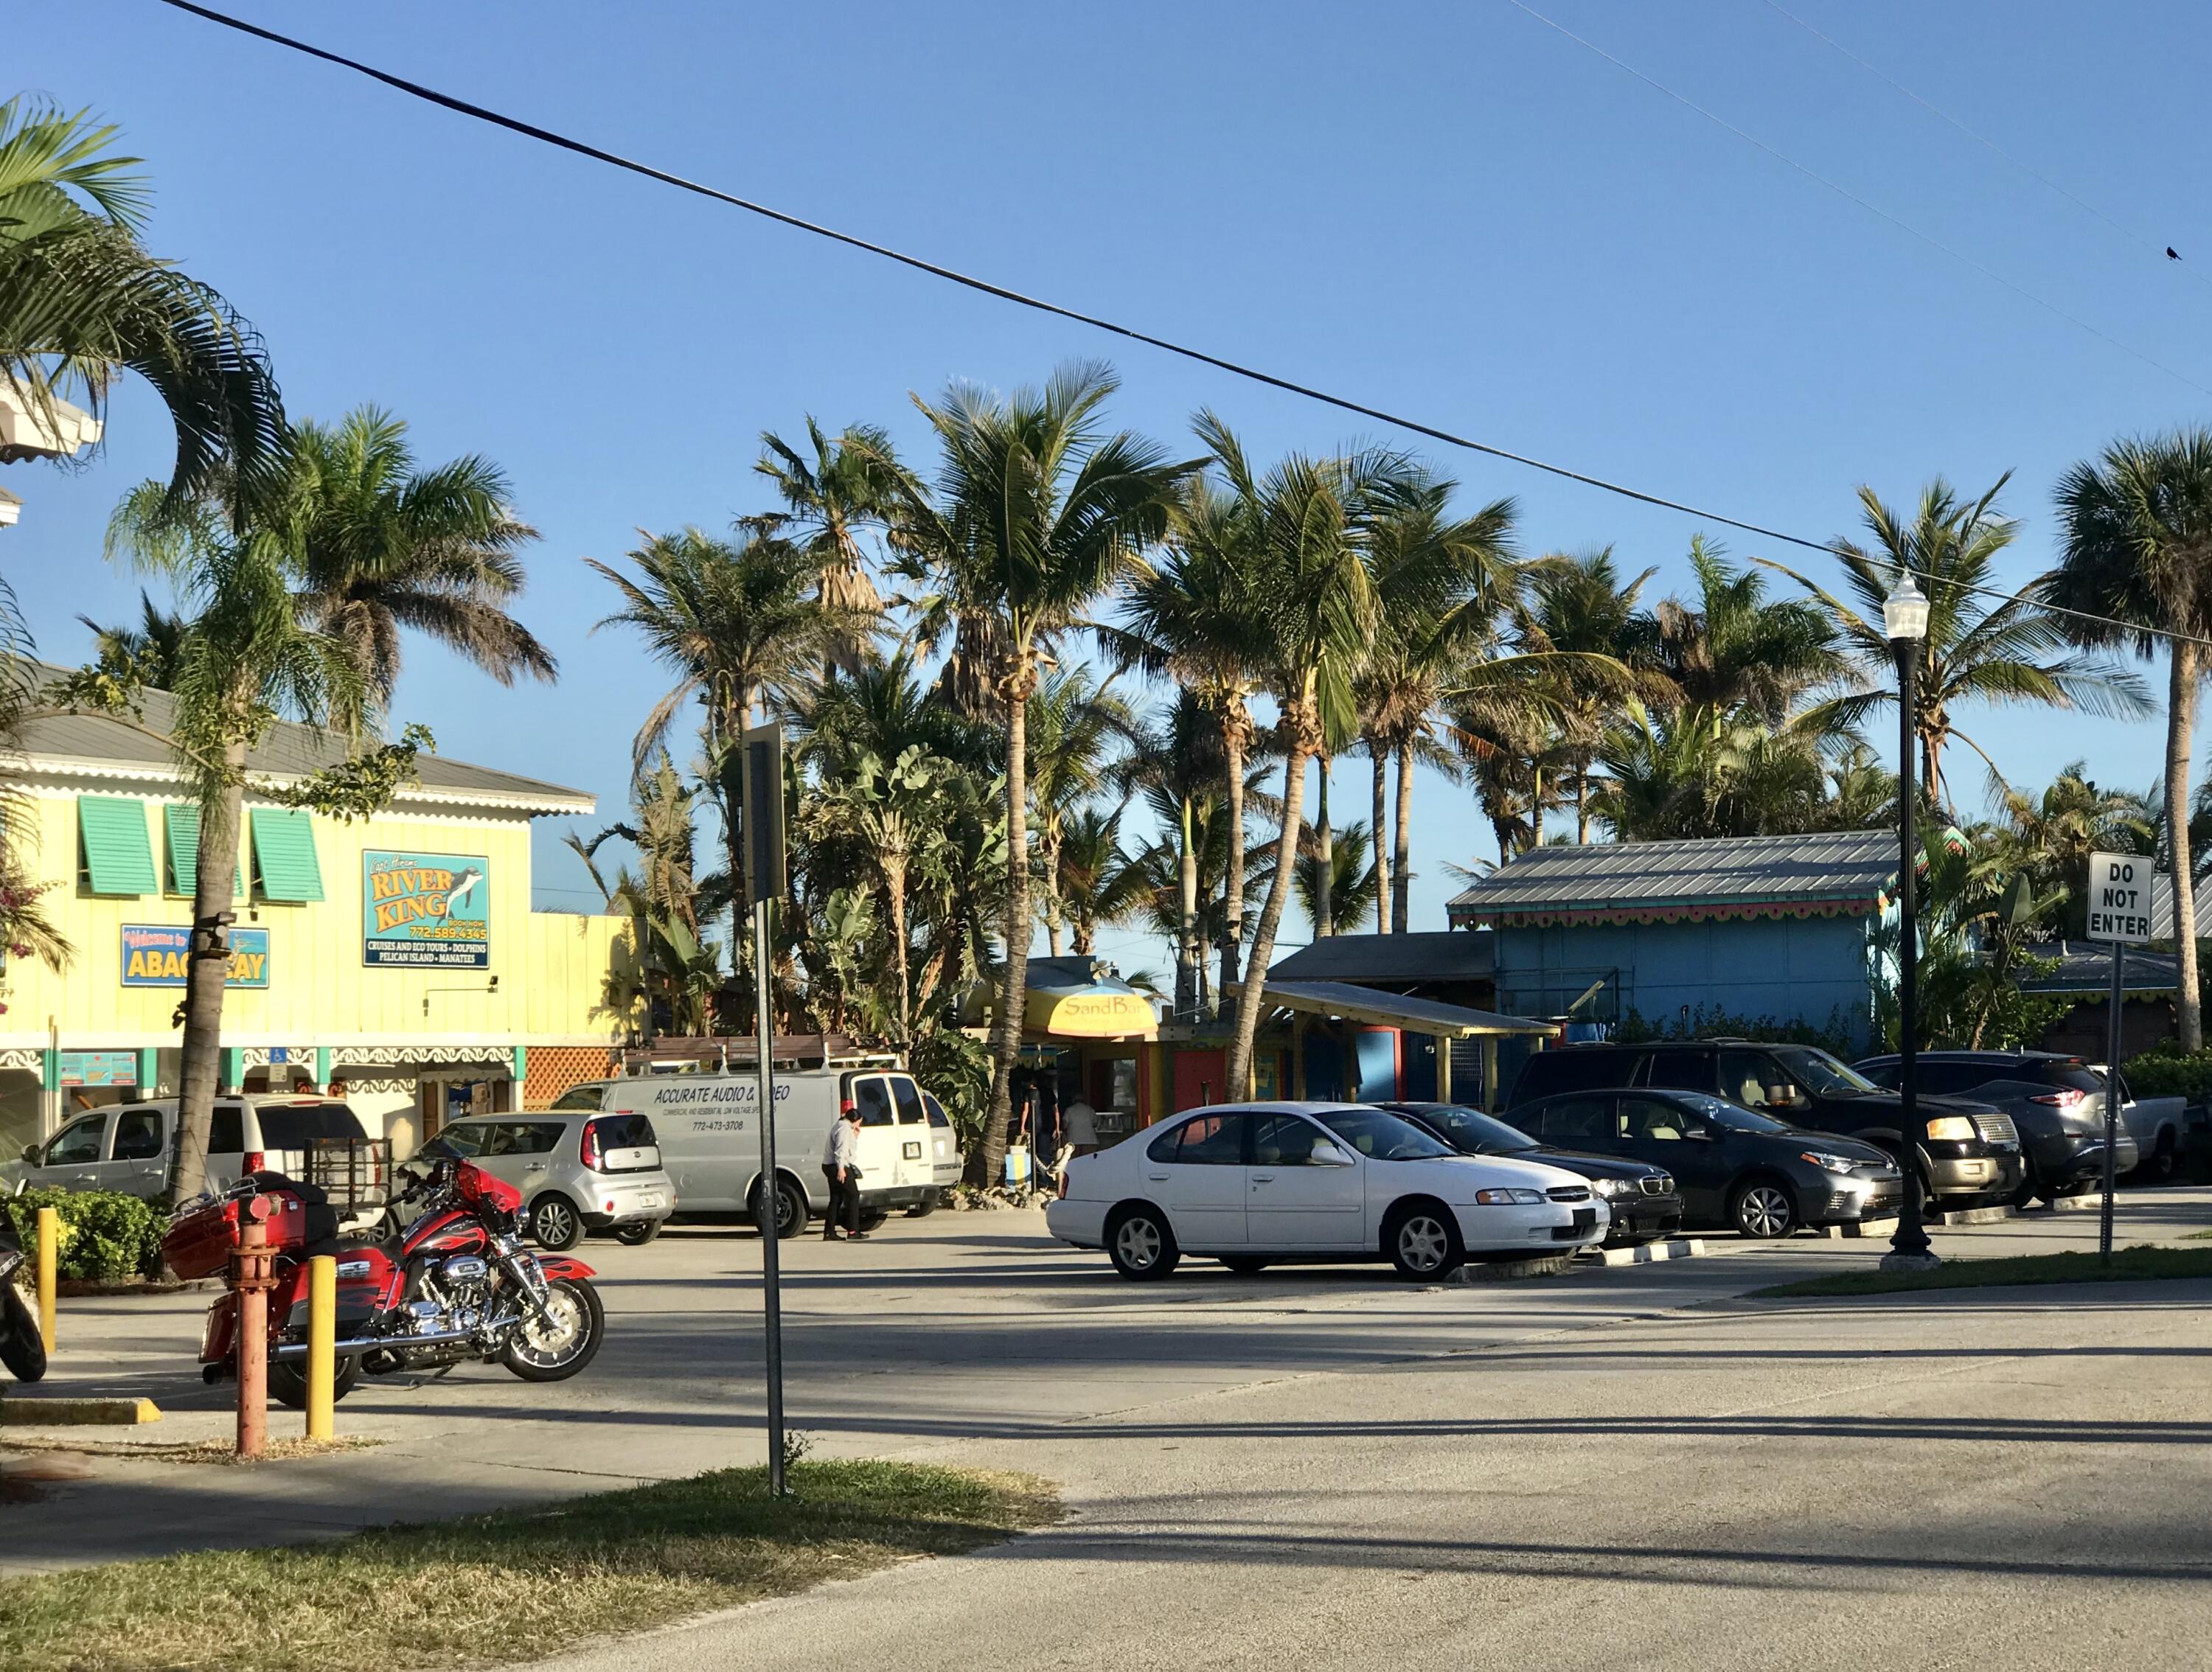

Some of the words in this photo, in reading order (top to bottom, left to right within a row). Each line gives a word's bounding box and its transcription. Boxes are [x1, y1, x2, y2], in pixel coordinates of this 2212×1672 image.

[2110, 863, 2133, 882] DO
[371, 868, 452, 901] RIVER
[2103, 888, 2138, 909] NOT
[375, 893, 447, 933] KING
[409, 926, 487, 940] 772.589.4345
[2091, 913, 2148, 936] ENTER
[367, 941, 396, 951] CRUISES
[397, 942, 411, 951] AND
[413, 943, 425, 952] ECO
[426, 943, 448, 952] TOURS
[453, 944, 486, 953] DOLPHINS
[379, 952, 409, 961] PELICAN
[409, 952, 434, 962] ISLAND
[439, 953, 476, 963] MANATEES
[654, 1087, 711, 1104] ACCURATE
[710, 1087, 745, 1102] AUDIO
[746, 1086, 754, 1101] &
[692, 1121, 744, 1132] 772-473-3708
